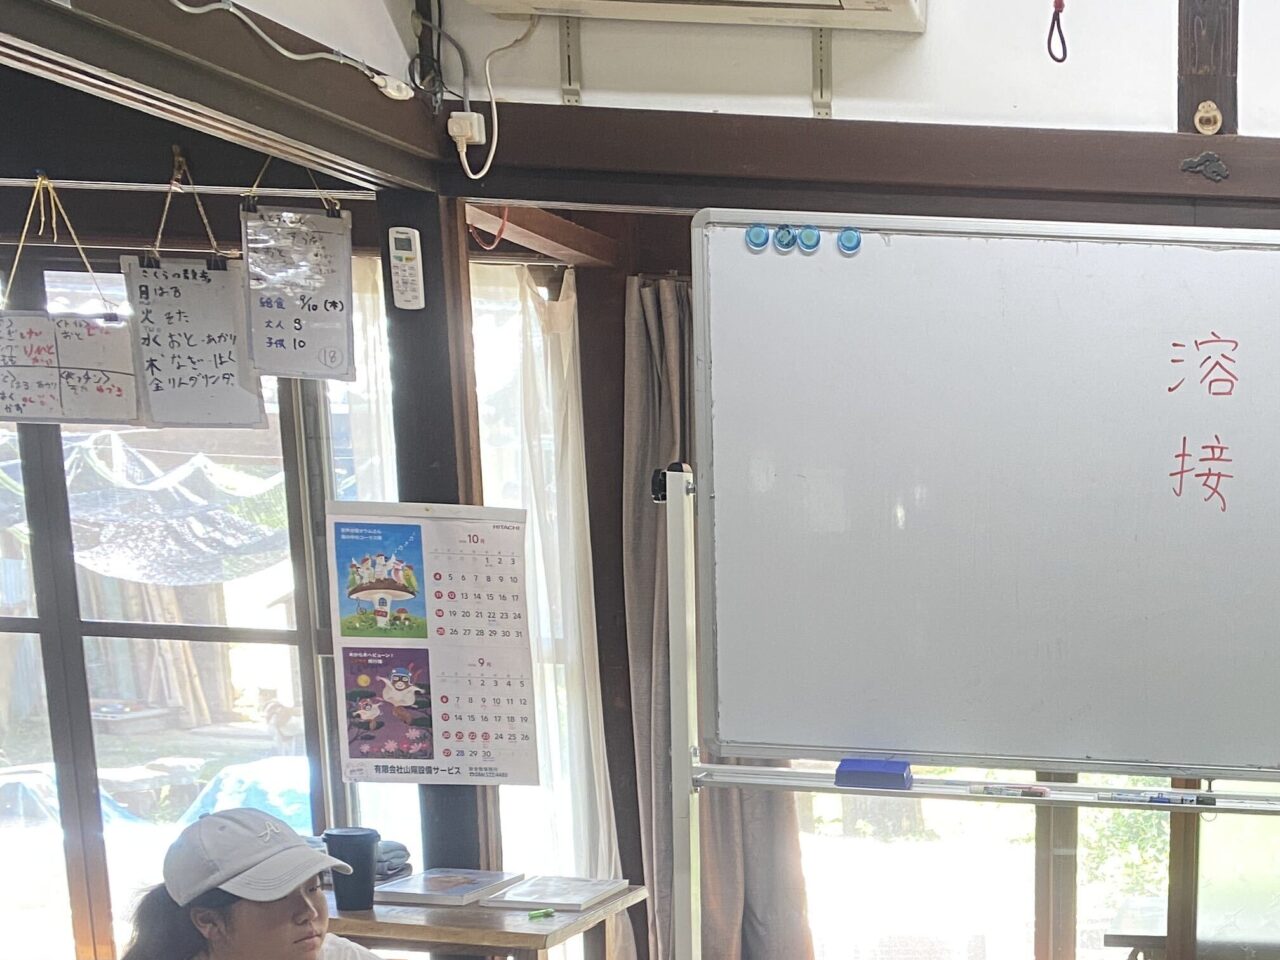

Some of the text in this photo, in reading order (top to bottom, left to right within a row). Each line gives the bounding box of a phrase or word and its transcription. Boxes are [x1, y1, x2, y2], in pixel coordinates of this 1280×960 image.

[140, 333, 161, 347] 水
[293, 337, 306, 350] 10
[322, 348, 337, 364] 18
[145, 356, 162, 376] 木
[1168, 331, 1239, 512] 溶接
